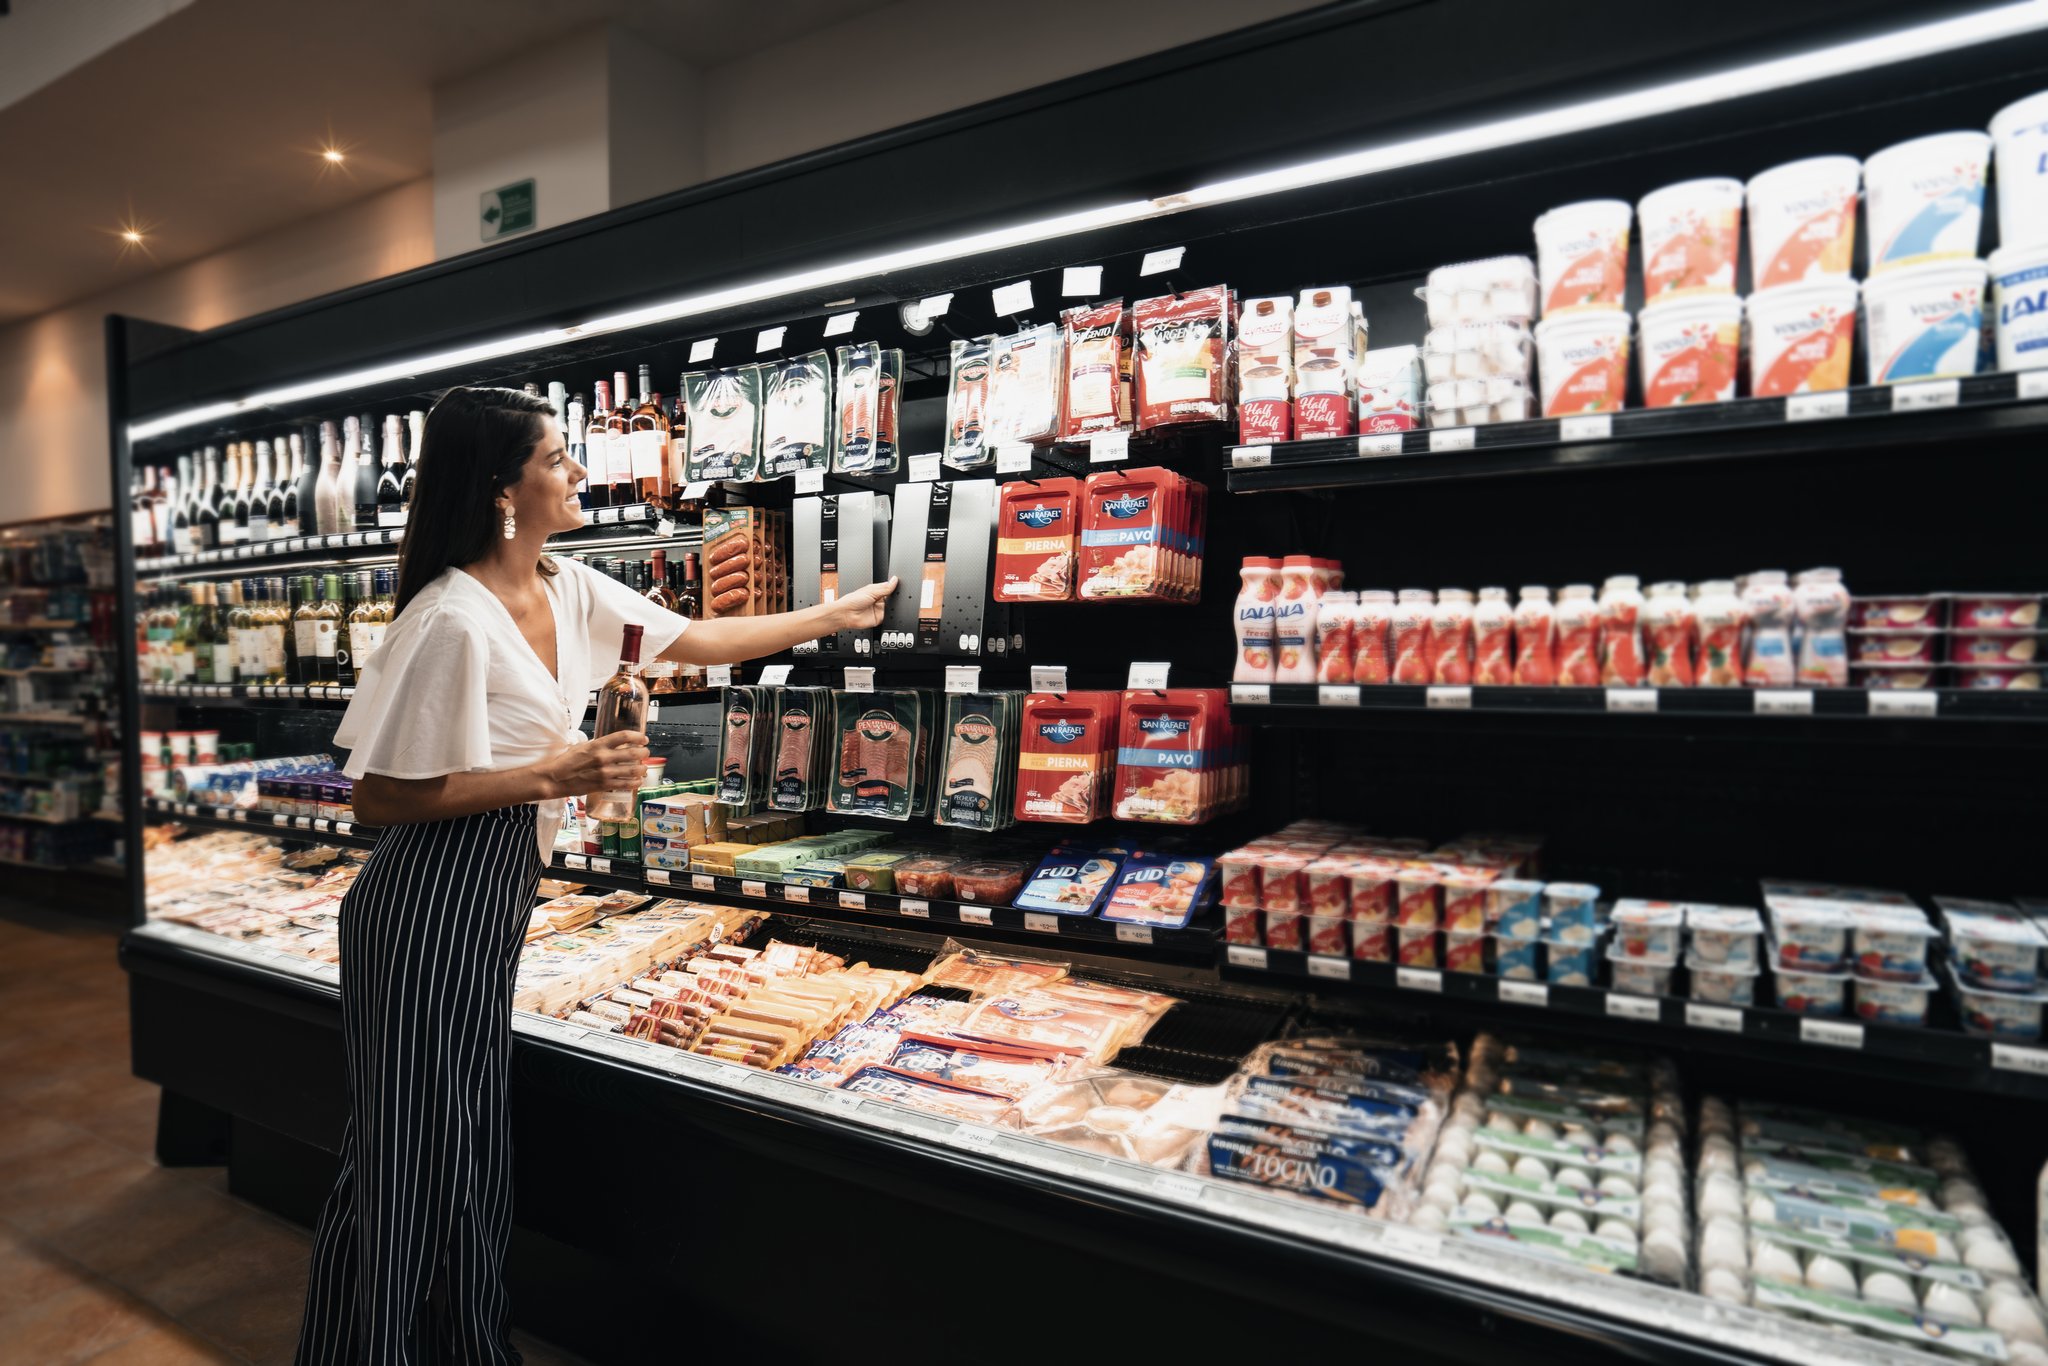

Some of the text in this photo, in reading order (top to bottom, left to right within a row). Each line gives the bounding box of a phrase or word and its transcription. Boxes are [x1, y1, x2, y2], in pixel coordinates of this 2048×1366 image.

[1245, 402, 1273, 417] Half
[1300, 396, 1329, 412] Half
[1250, 415, 1279, 431] Half
[1305, 410, 1335, 426] Half
[1104, 498, 1149, 514] SAN RAFAEL
[1018, 509, 1061, 523] SAN RAFAEL
[1119, 530, 1152, 542] PAVO
[1024, 540, 1066, 551] PIERNA
[1240, 607, 1275, 621] LALA
[1277, 603, 1304, 618] ALA
[858, 720, 898, 732] PEÑARANDA
[956, 725, 994, 736] PEÑARANDA
[1042, 725, 1084, 740] SAN RAFAEL
[1142, 720, 1189, 736] SAN RAFAEL
[1047, 757, 1089, 768] PIERNA
[1158, 753, 1193, 765] PAVO
[781, 781, 799, 789] SALAMI
[954, 795, 978, 803] PECHUGA
[1037, 867, 1078, 878] FUD
[1123, 868, 1163, 884] FUD
[1316, 1089, 1349, 1100] KIRKLAND
[1293, 1128, 1328, 1140] KIRKLAND
[1281, 1147, 1317, 1159] KIRKLAND
[1252, 1154, 1337, 1189] TOCINO
